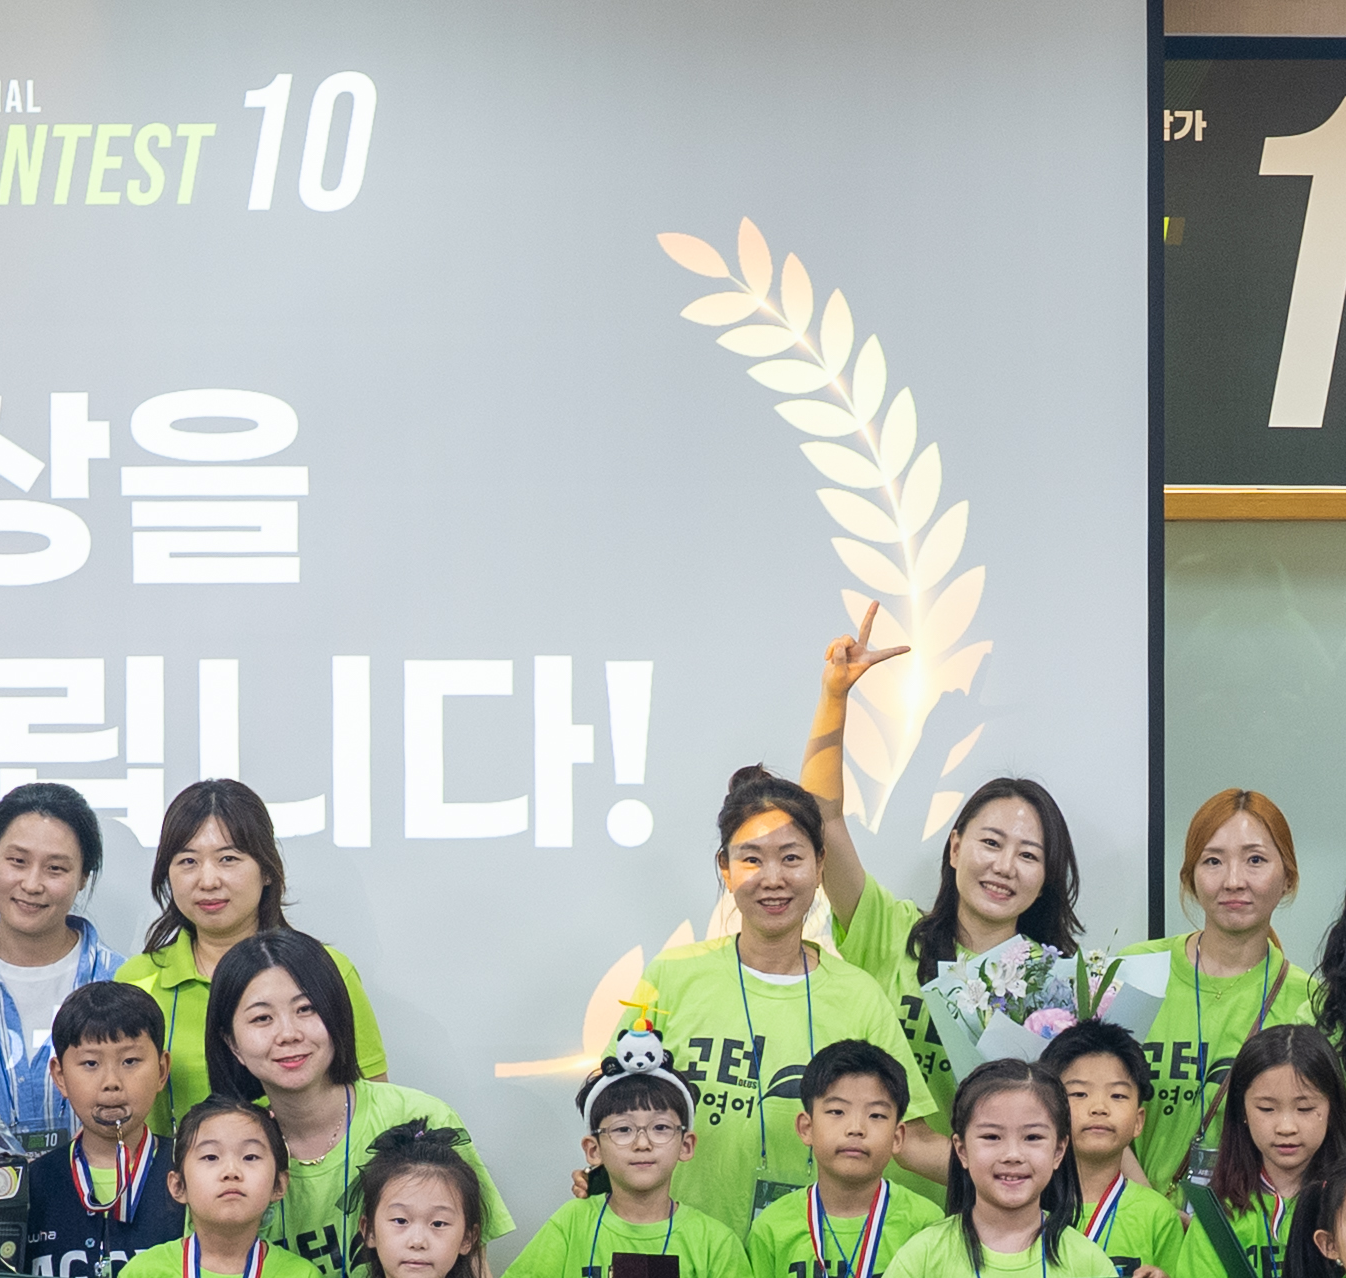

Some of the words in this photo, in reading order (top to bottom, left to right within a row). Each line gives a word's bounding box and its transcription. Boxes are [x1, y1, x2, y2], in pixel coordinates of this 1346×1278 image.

[243, 70, 377, 212] 10
[703, 1091, 754, 1125] 영어
[45, 1133, 58, 1147] 10
